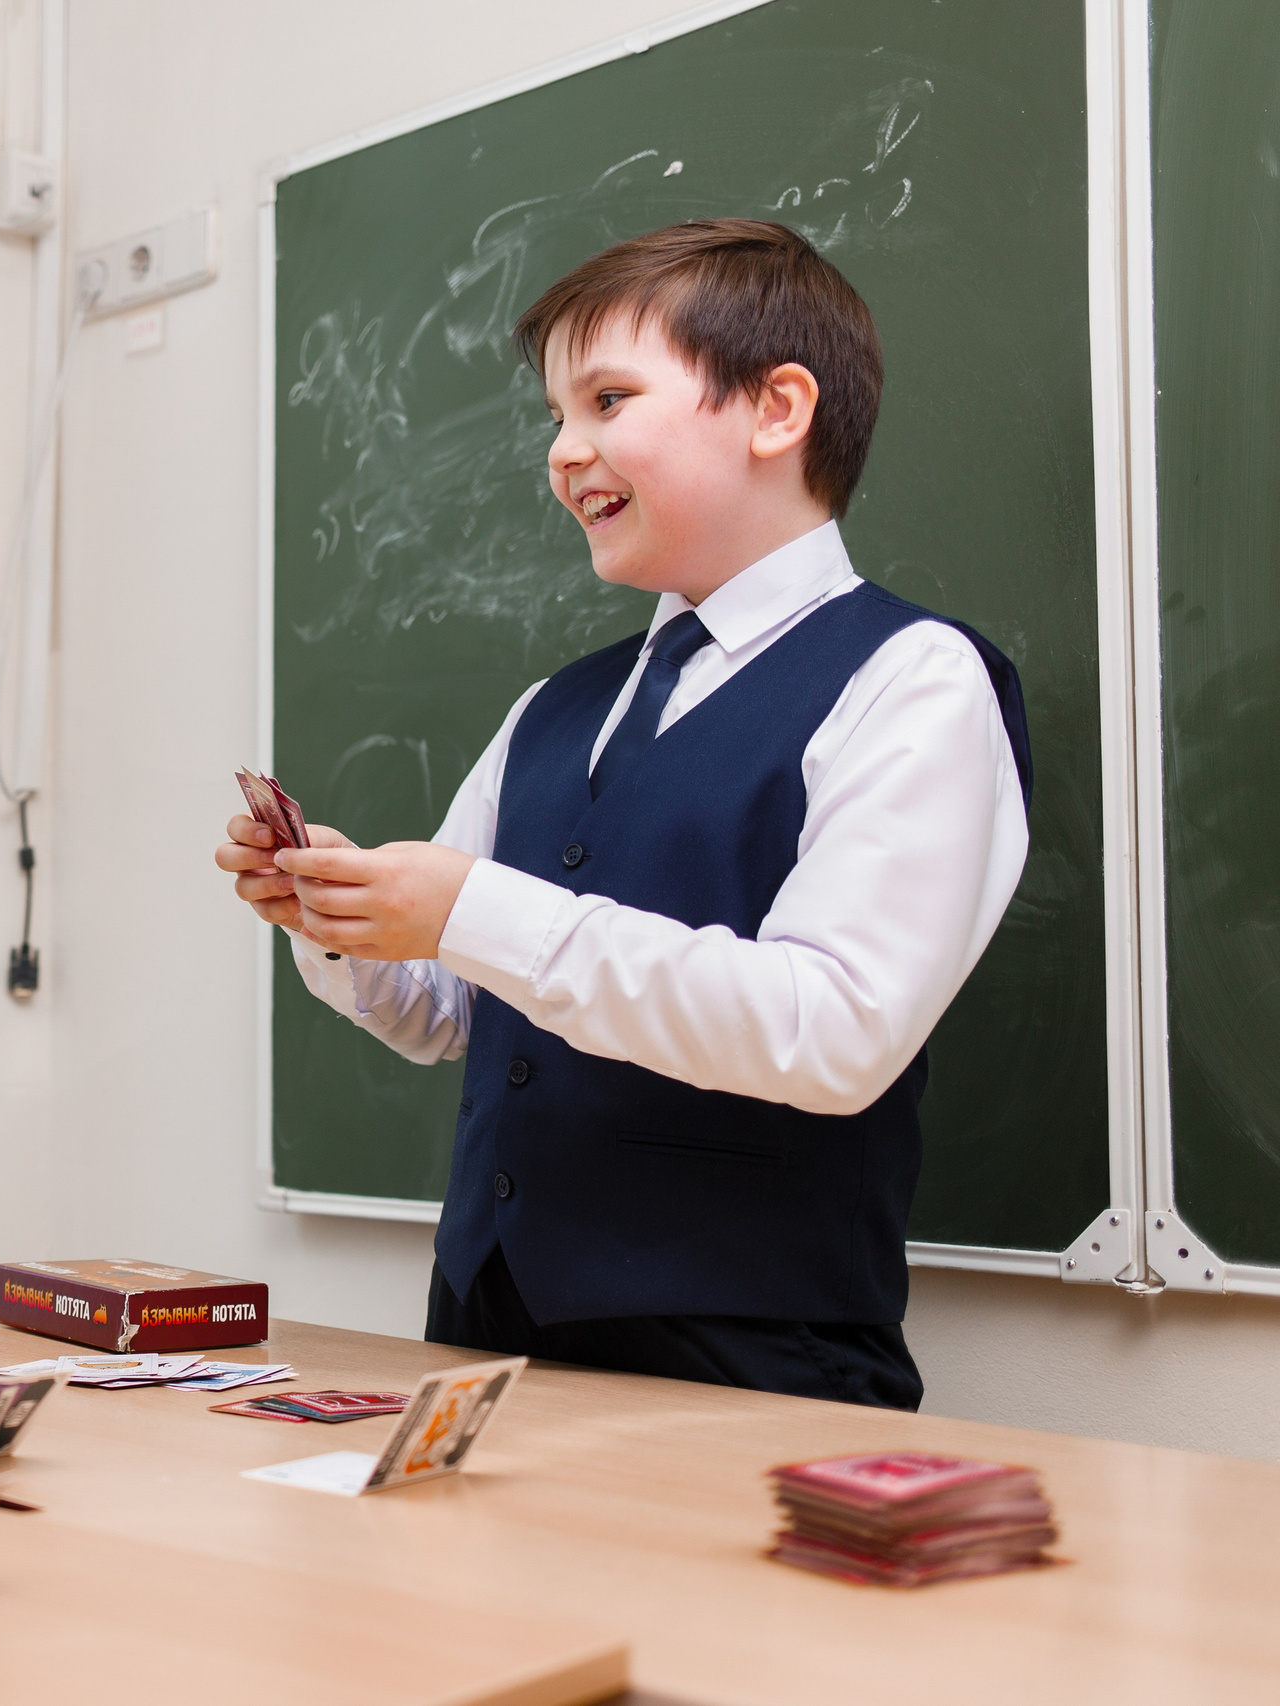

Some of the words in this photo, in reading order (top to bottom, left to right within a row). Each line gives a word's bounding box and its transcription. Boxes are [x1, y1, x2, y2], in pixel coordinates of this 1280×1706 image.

[4, 1279, 54, 1312] ВЗРЫВНЫЕ
[55, 1294, 90, 1320] КОТЯТА
[141, 1302, 209, 1327] ВЗРЫВНЫЕ
[212, 1303, 257, 1322] КОТЯТА
